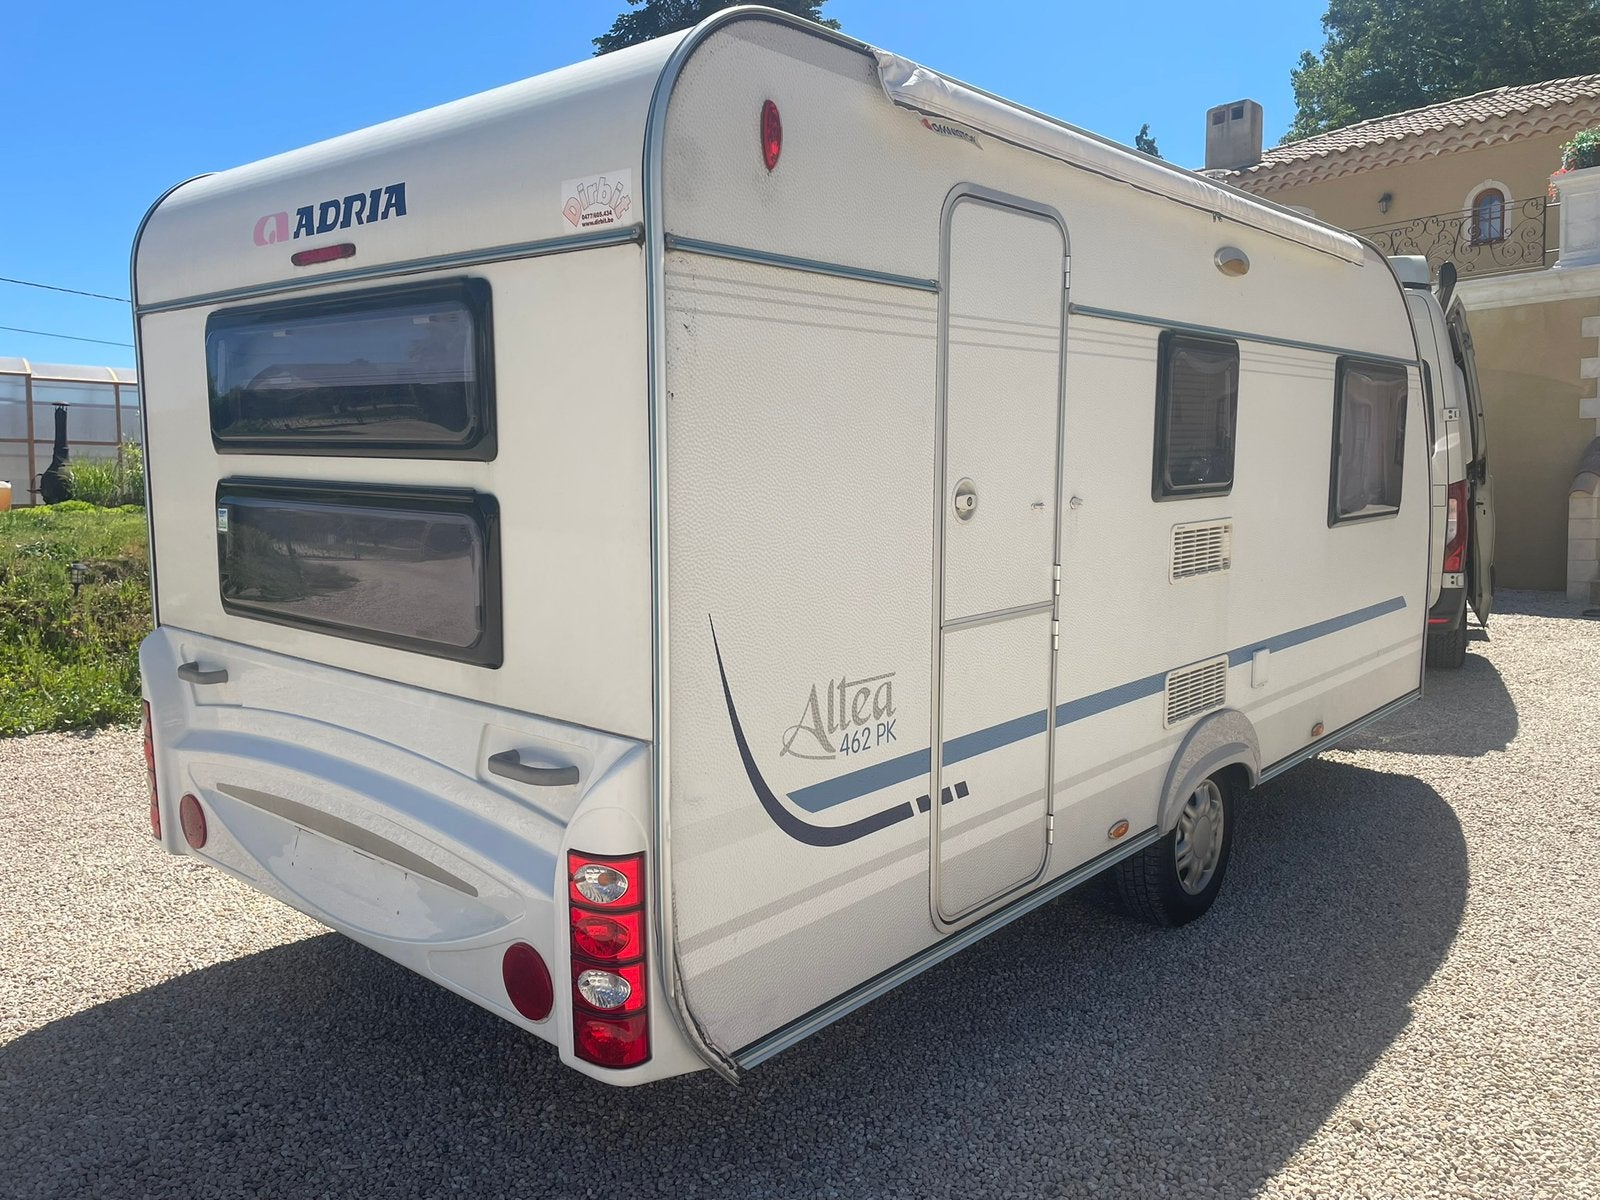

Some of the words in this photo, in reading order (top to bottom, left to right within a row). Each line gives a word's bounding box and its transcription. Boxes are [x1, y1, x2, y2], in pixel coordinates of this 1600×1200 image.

[293, 182, 407, 240] ADRIA
[562, 176, 632, 228] Dirbit
[581, 217, 614, 227] www.dirbit.be
[779, 671, 897, 760] Altea
[839, 726, 871, 756] 462
[876, 718, 897, 746] PK
